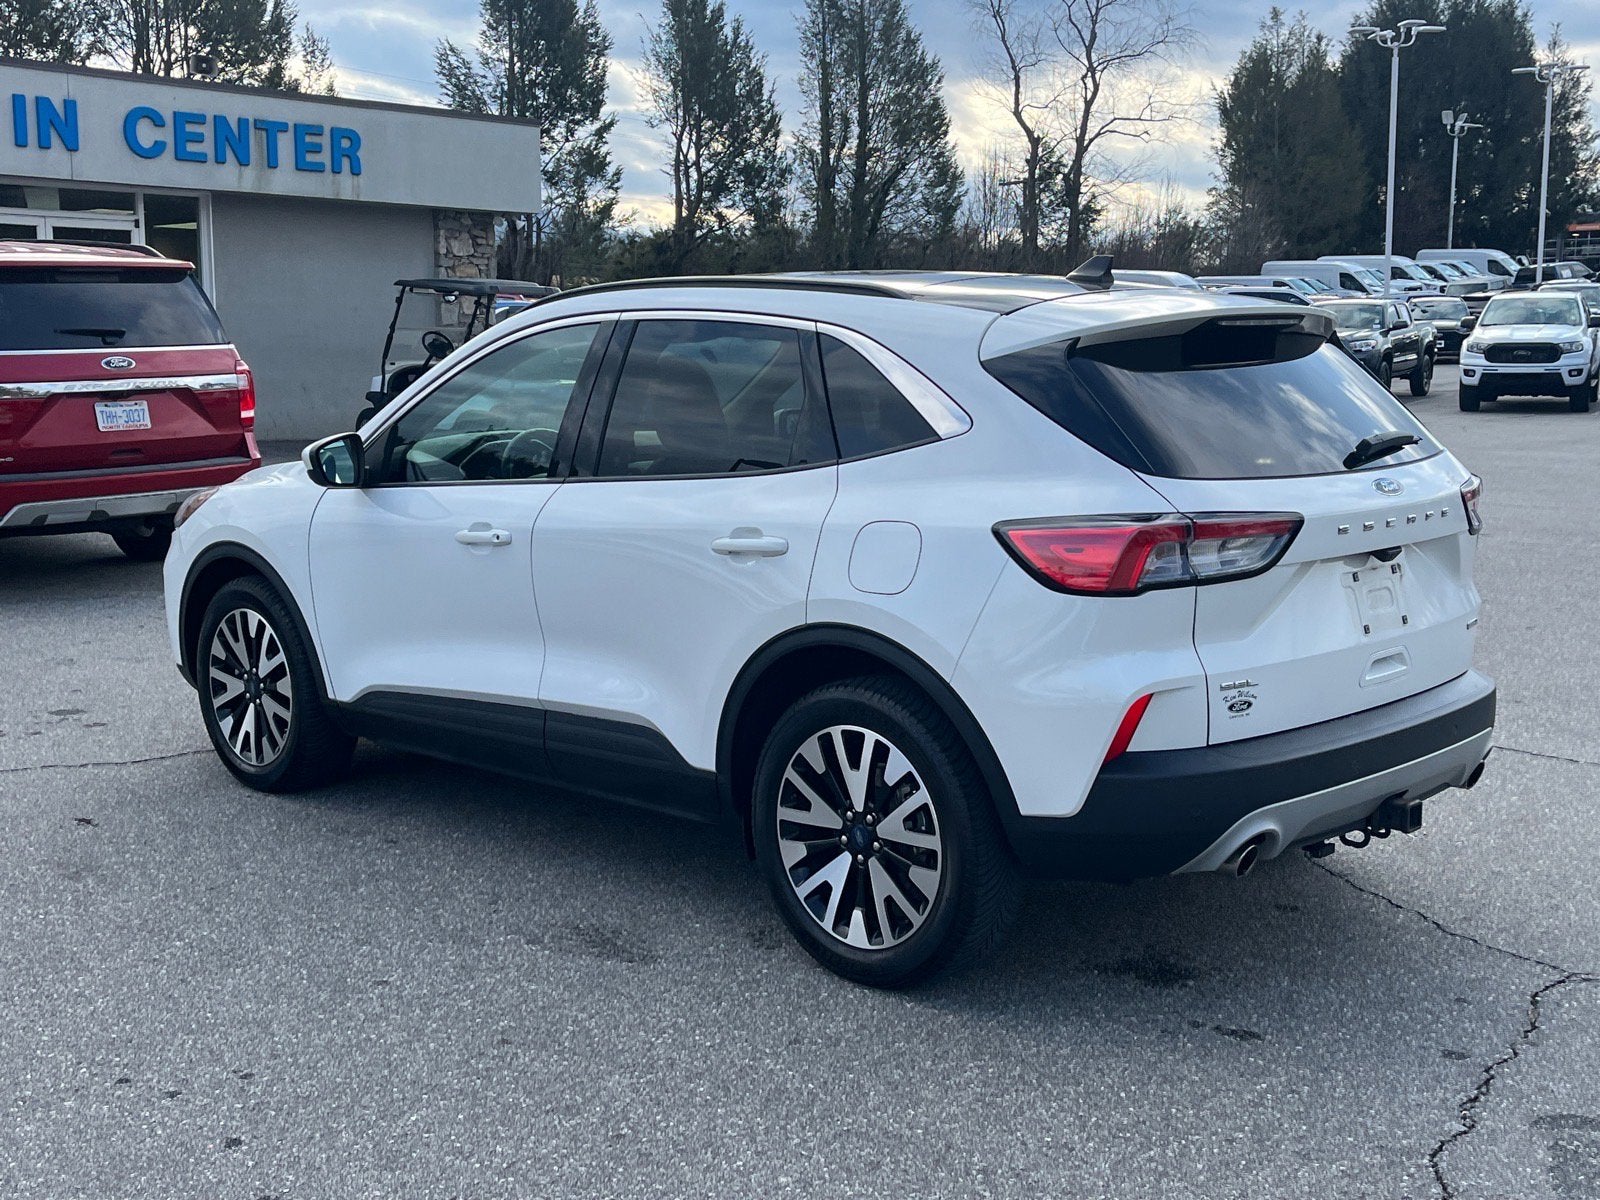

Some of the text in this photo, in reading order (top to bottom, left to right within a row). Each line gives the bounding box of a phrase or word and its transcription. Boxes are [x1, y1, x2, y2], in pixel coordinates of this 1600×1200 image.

[12, 93, 362, 175] IN CENTER
[64, 380, 179, 391] EXPEDITION
[99, 408, 147, 425] THH-3037
[1337, 507, 1449, 535] ESCAPE
